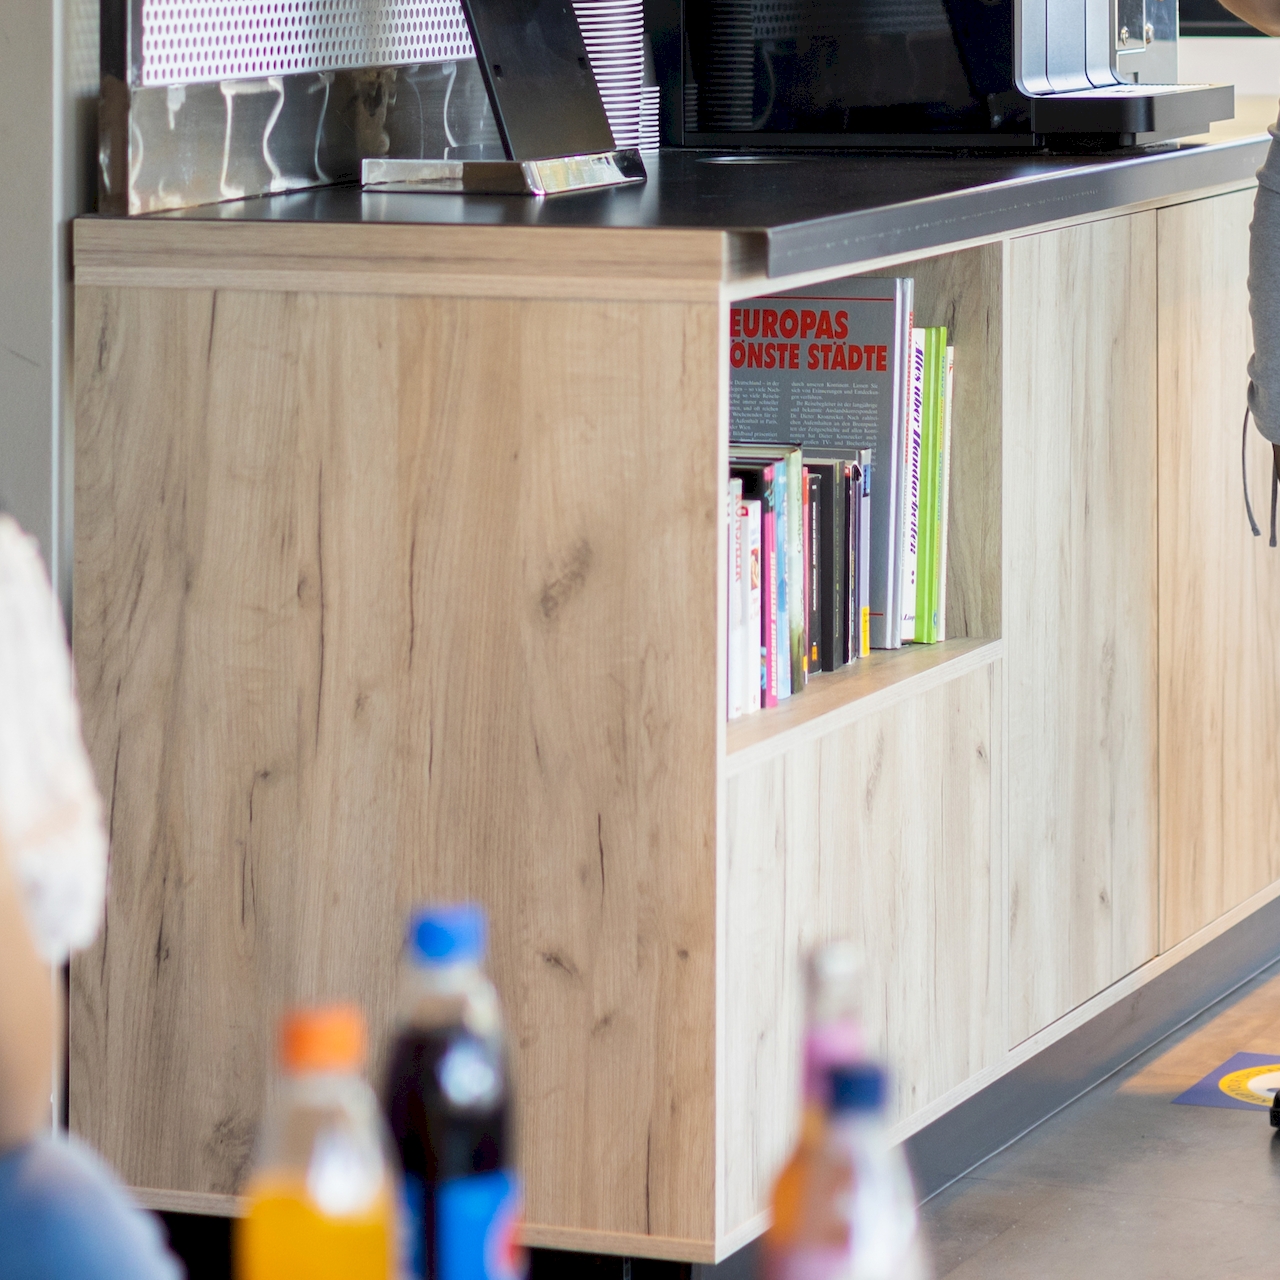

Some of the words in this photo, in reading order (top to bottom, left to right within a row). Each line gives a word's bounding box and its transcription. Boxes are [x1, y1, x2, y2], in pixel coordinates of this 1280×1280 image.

[730, 309, 849, 339] EUROPAS
[730, 339, 799, 369] ÖNSTE
[808, 341, 887, 371] STÄDTE
[915, 341, 923, 382] Alles
[913, 386, 922, 428] über
[910, 429, 921, 554] Handarbeiten
